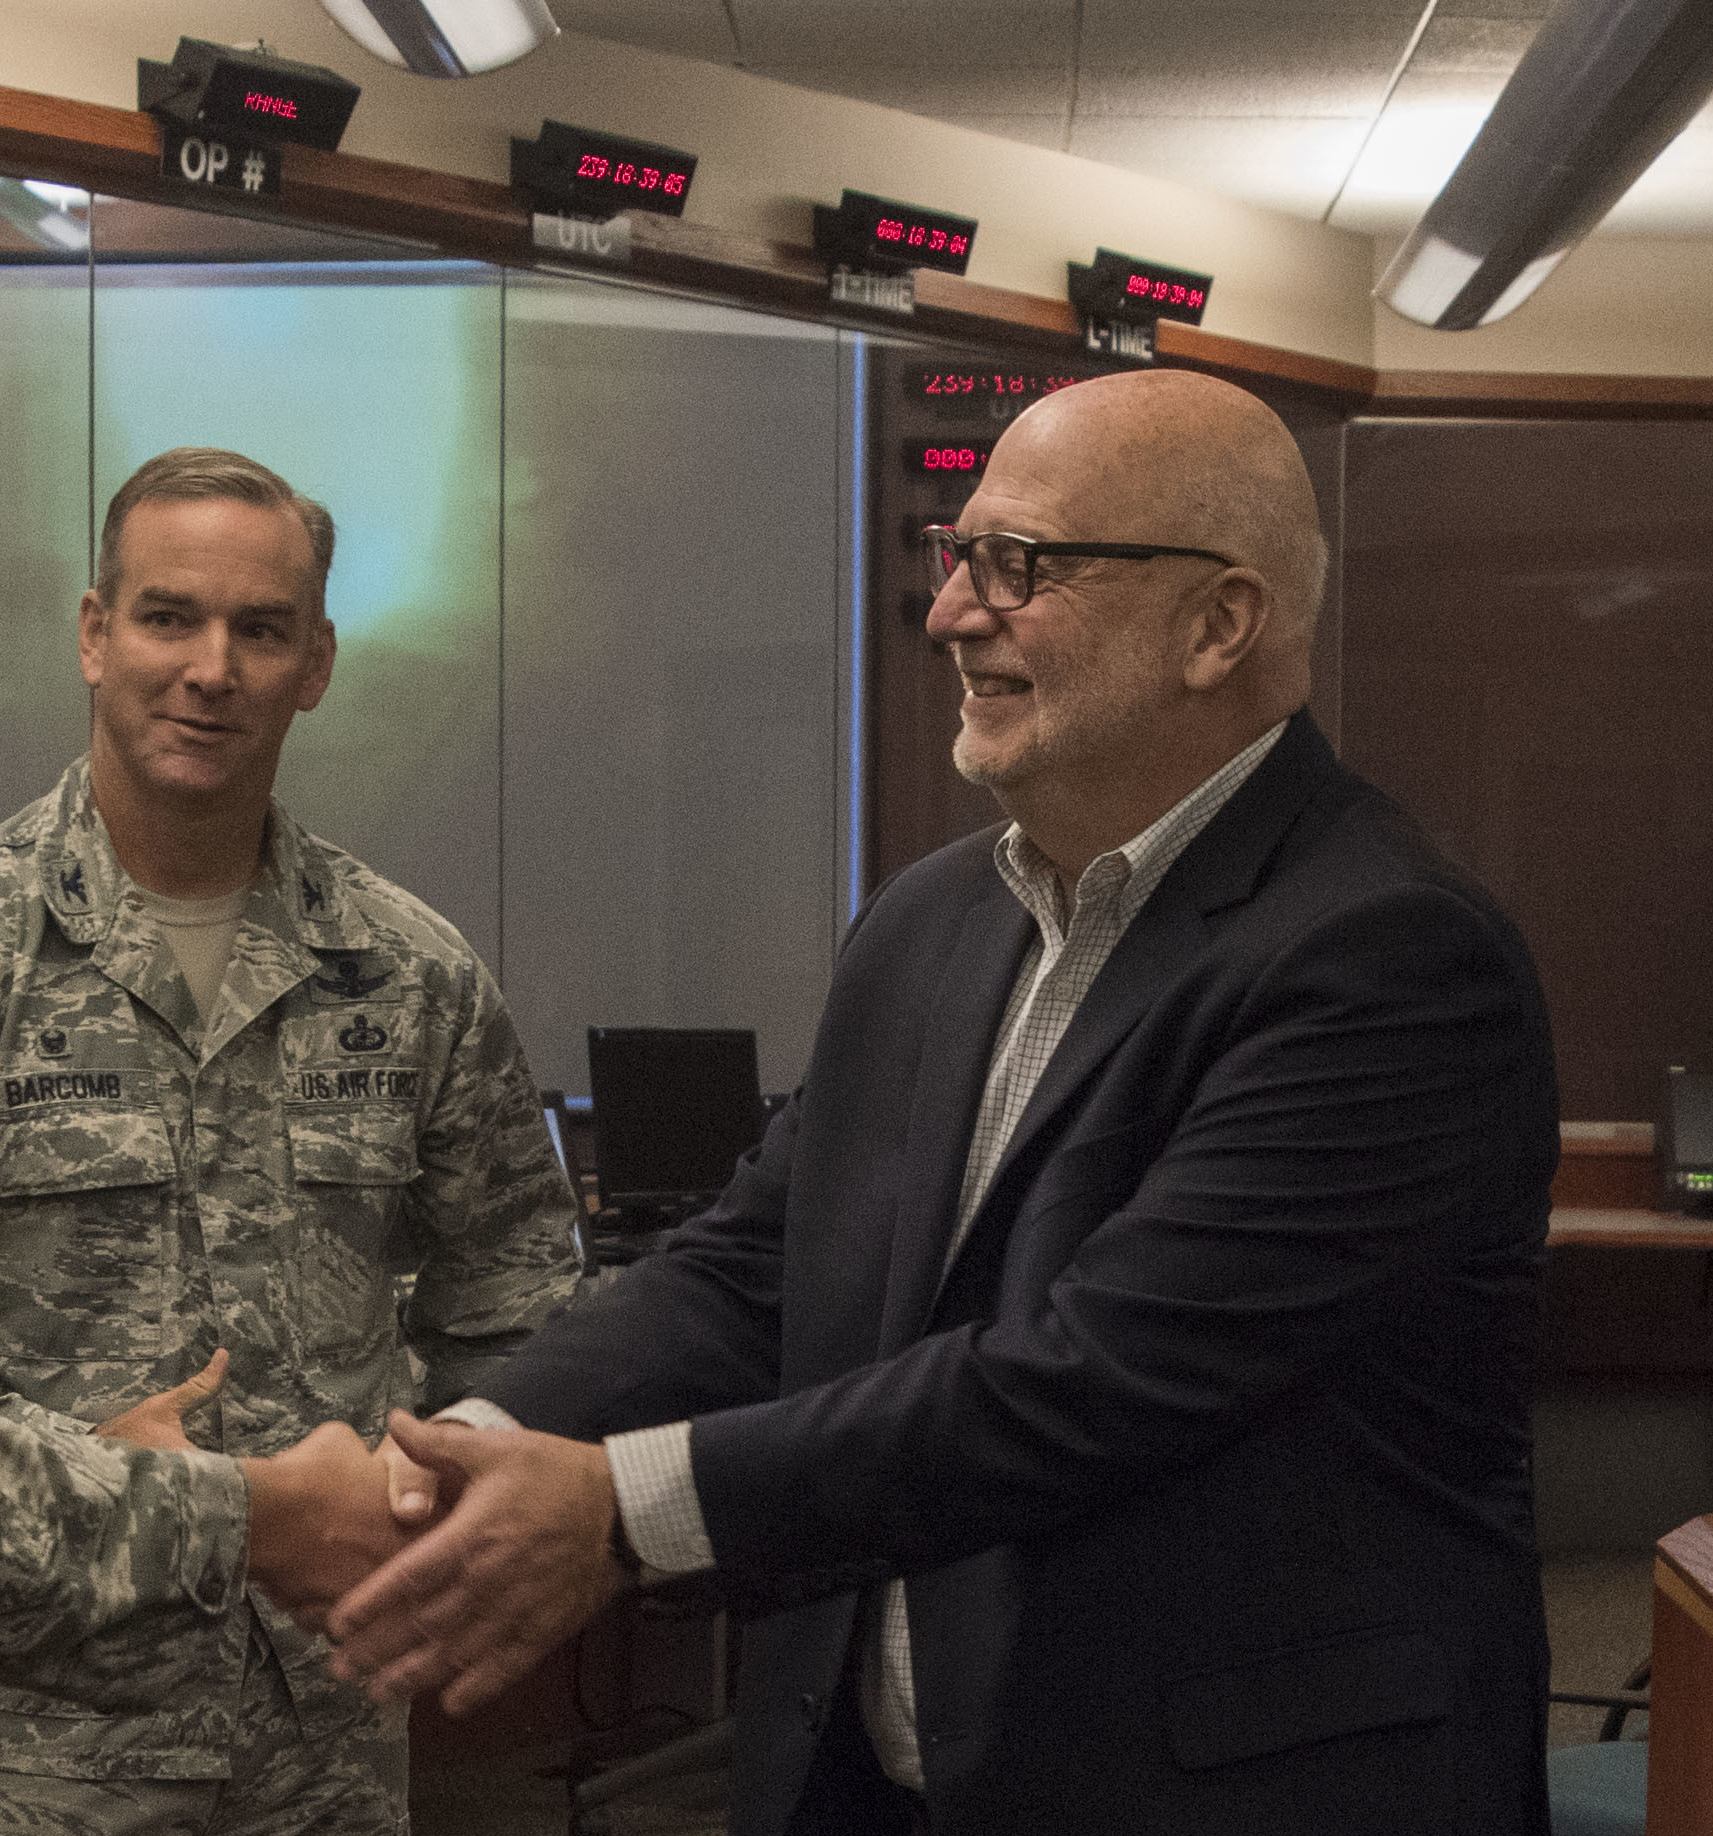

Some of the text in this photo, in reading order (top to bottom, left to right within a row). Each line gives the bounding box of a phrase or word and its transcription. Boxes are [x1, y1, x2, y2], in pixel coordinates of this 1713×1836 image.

[180, 139, 265, 193] OP #
[1088, 317, 1154, 361] L-TIME
[4, 1073, 122, 1107] BARCOMB
[300, 1073, 330, 1100] US
[338, 1069, 370, 1099] AIR
